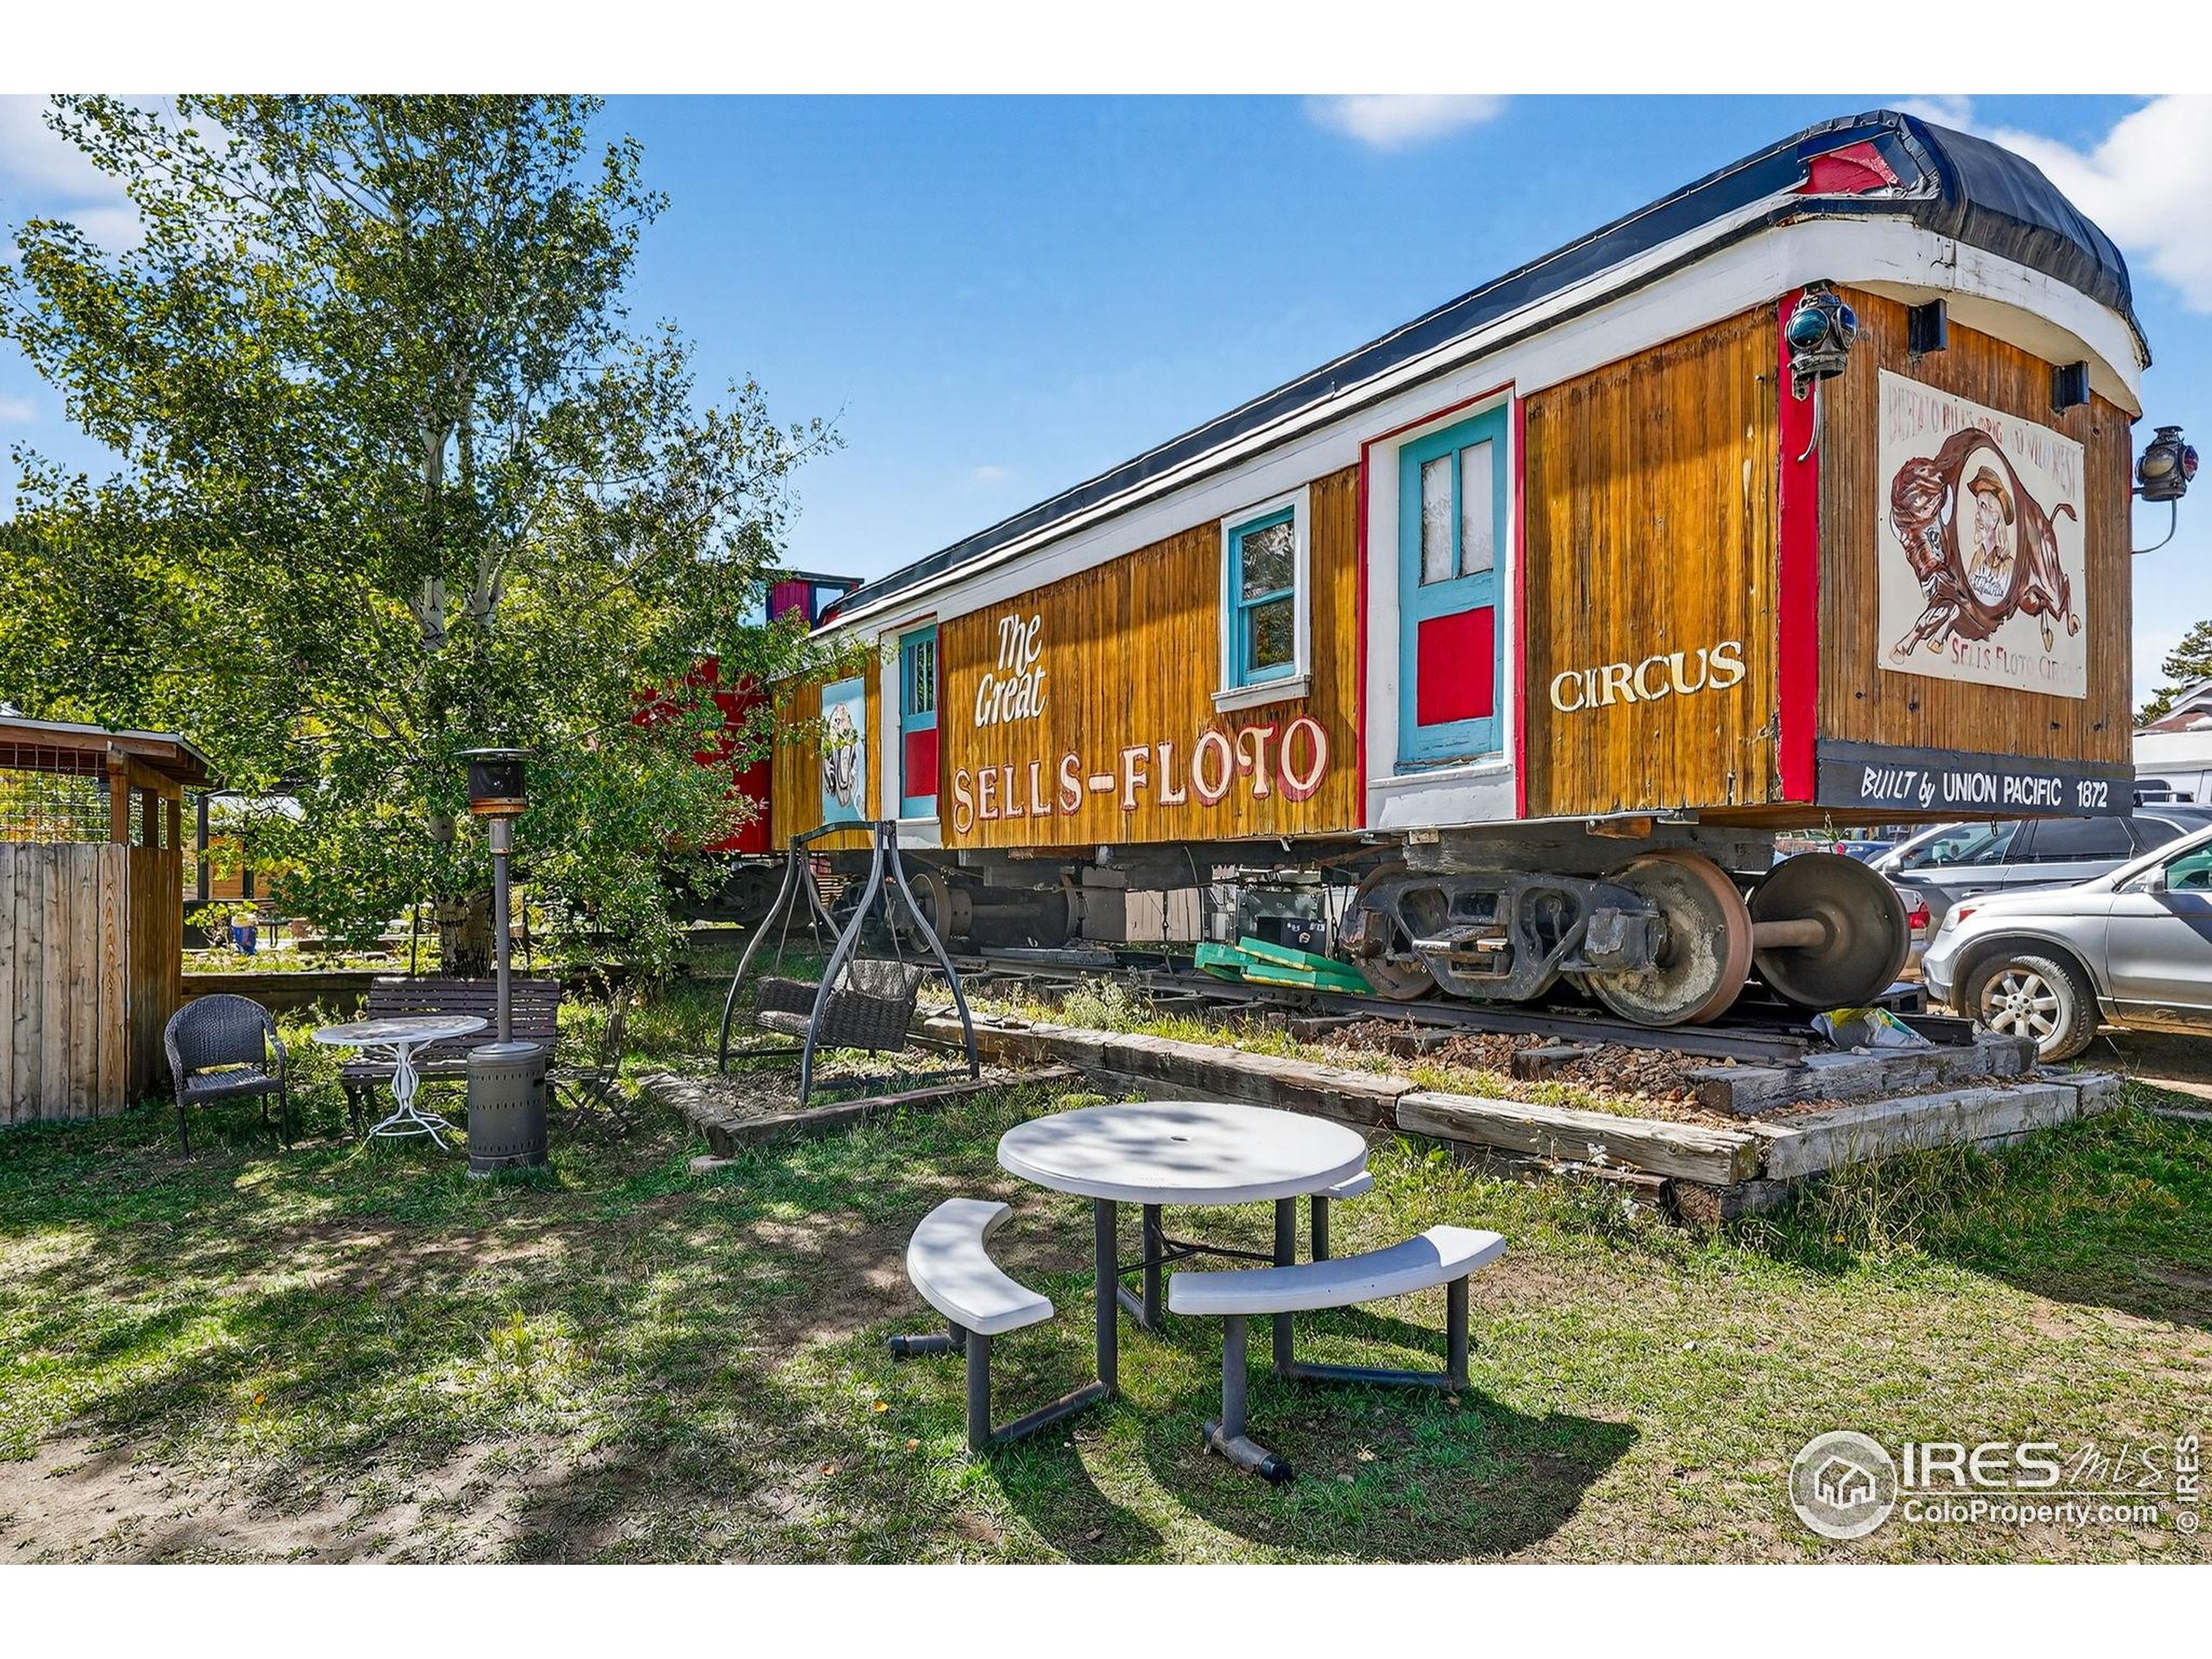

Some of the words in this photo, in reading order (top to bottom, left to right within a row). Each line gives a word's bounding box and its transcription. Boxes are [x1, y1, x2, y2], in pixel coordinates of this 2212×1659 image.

[997, 613, 1043, 677] The
[974, 670, 1047, 728] Great
[1550, 640, 1746, 713] CIRCUS
[1860, 766, 1917, 800] BUILT
[1918, 772, 1936, 809] by
[1943, 772, 1997, 803] UNION
[2003, 775, 2063, 806] PACIFIC
[2075, 779, 2108, 809] 1872
